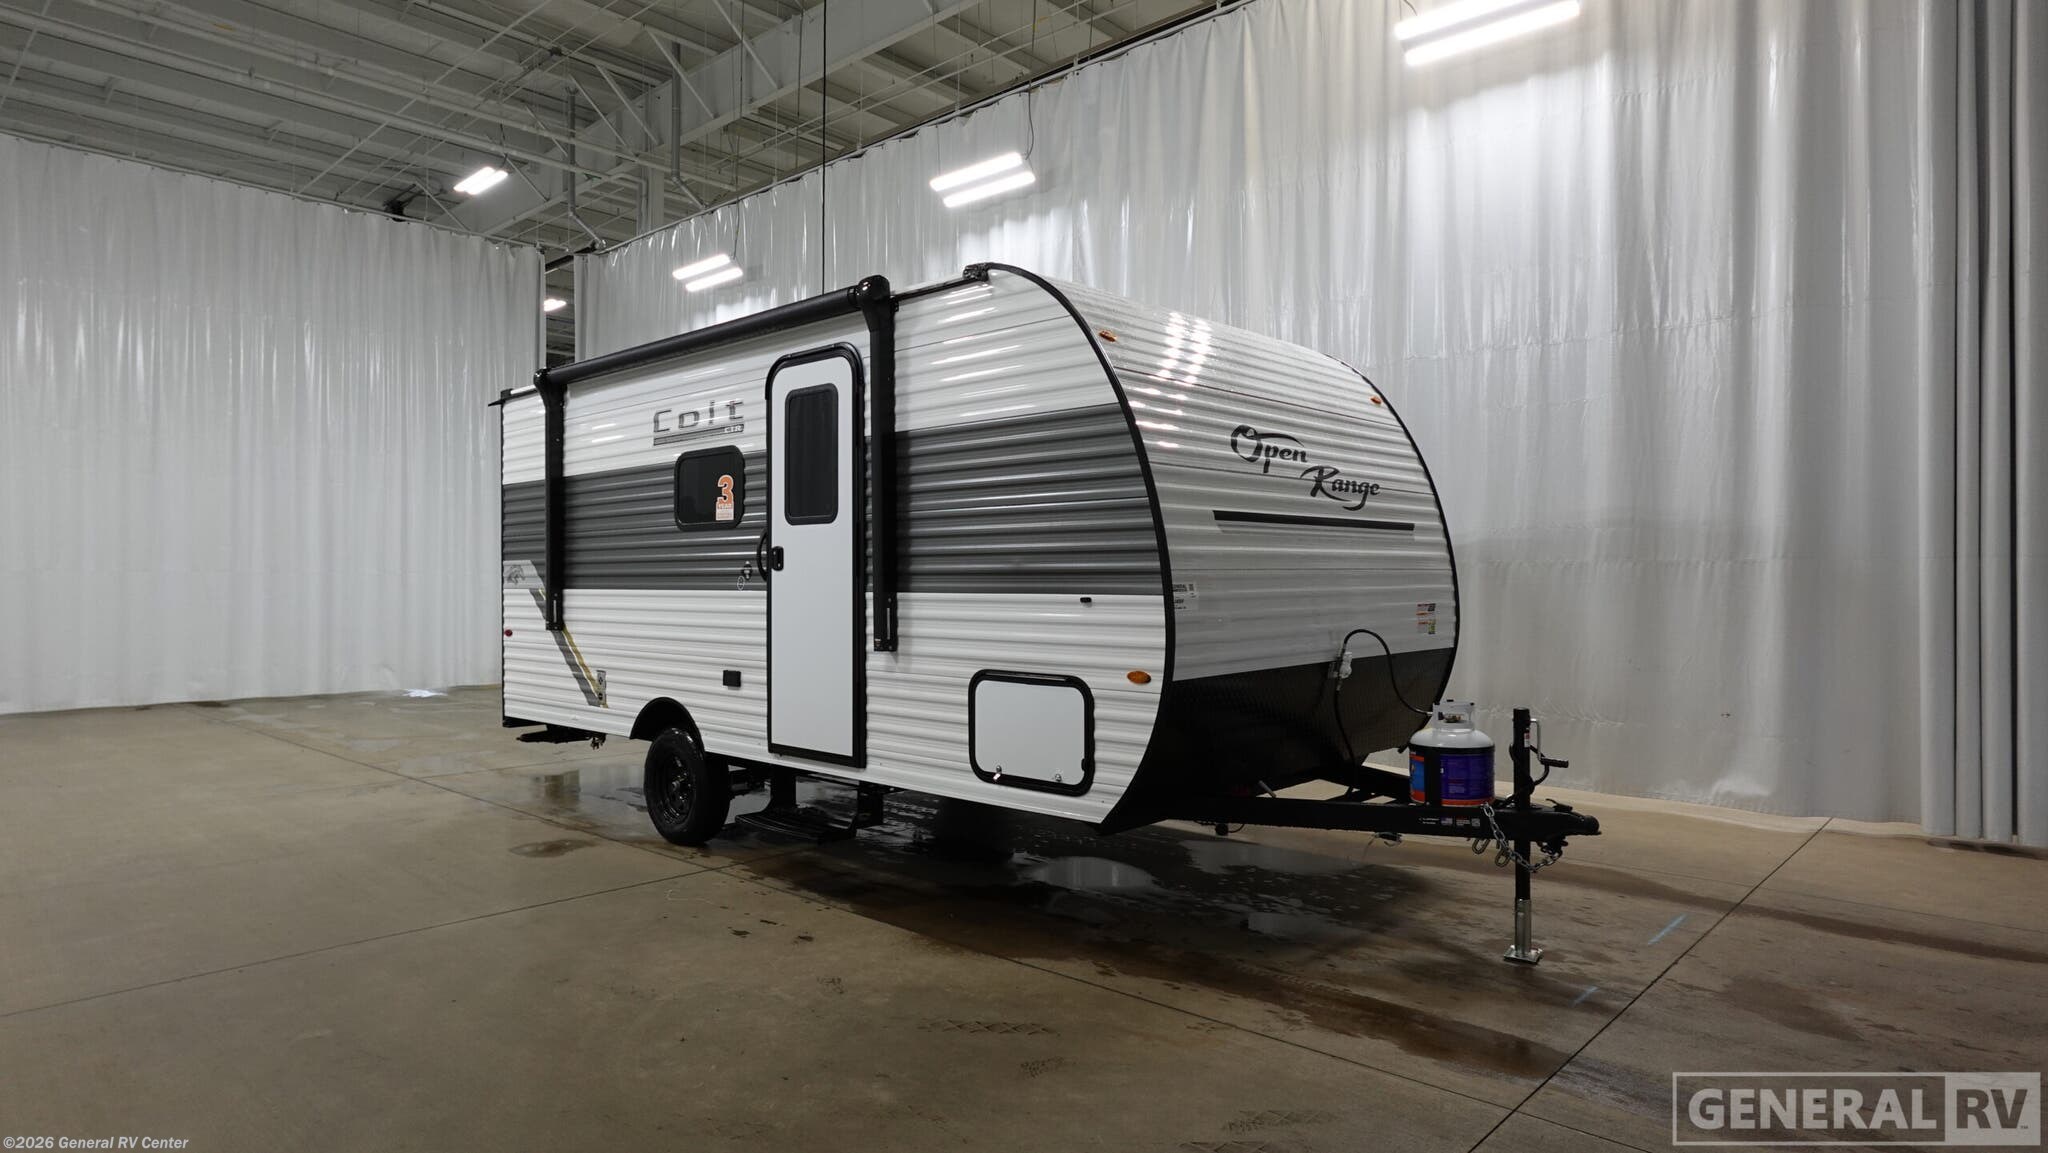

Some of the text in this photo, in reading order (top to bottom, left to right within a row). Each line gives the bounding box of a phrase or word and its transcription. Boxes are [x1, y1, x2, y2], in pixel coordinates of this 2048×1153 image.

[653, 400, 744, 434] Colt
[1230, 424, 1309, 474] Open
[717, 474, 735, 504] 3
[1299, 465, 1382, 512] Range
